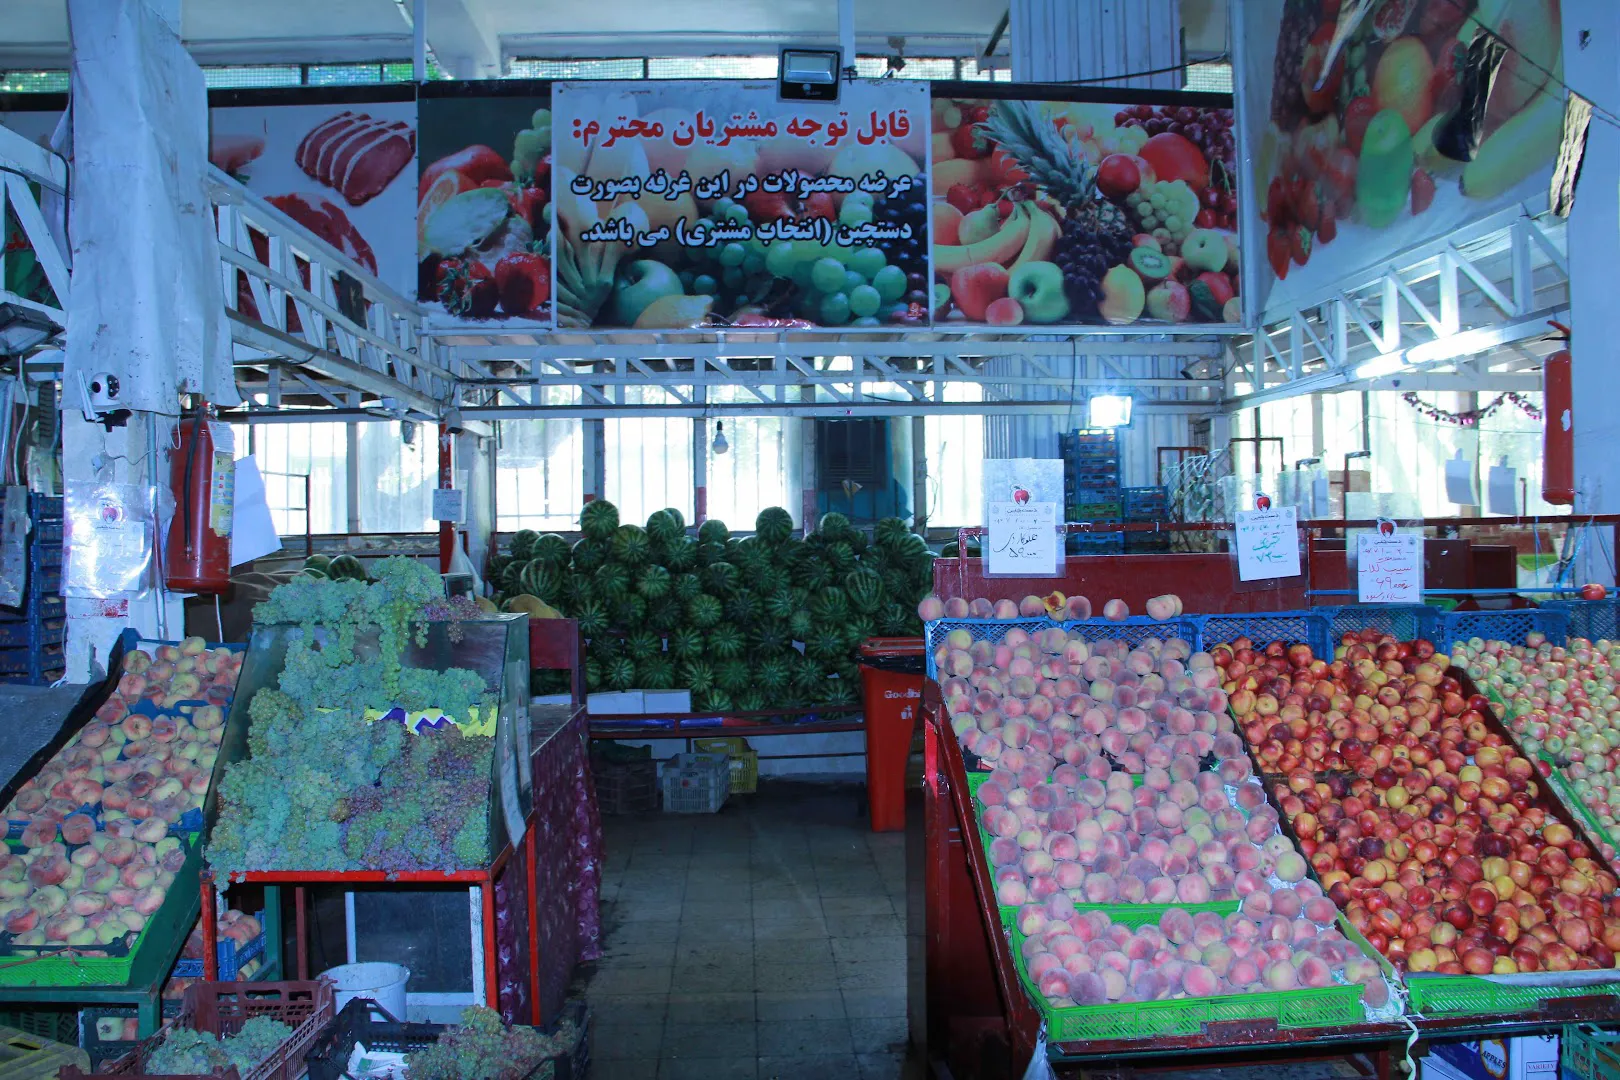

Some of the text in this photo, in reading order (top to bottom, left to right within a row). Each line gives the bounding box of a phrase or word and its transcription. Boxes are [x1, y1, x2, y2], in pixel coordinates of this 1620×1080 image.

[573, 110, 910, 147] قابل توجه مشتریان محترم:
[571, 168, 912, 200] عرضه محصولات در این غرفه بصورت
[580, 215, 913, 248] دستچین (انتخاب مشتری) می باشد.
[1481, 1050, 1506, 1069] APPLES
[1527, 1063, 1555, 1071] VARIETY
